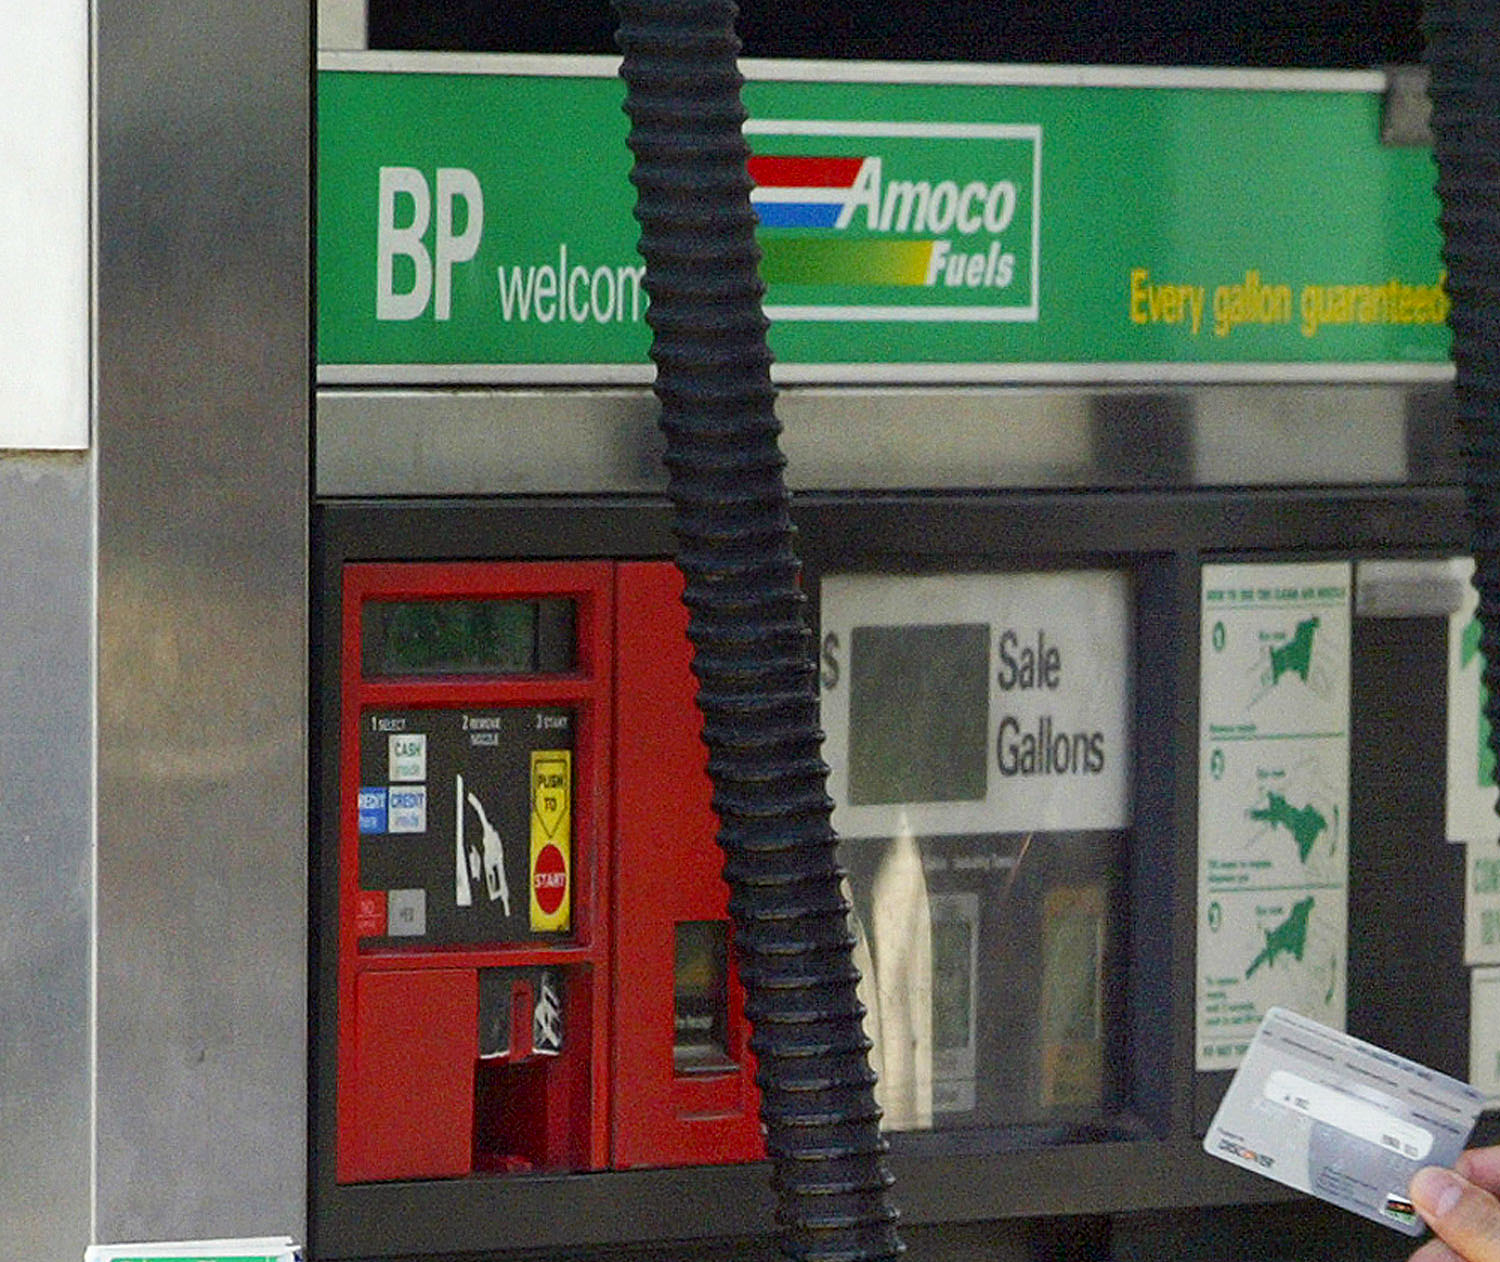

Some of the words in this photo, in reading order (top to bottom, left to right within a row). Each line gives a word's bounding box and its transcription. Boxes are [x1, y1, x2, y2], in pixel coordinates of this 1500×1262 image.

[834, 157, 1016, 234] Amoco
[376, 166, 484, 321] BP
[498, 244, 651, 323] welcom
[924, 240, 1015, 287] Fuels
[1130, 268, 1203, 335] Every
[1212, 268, 1292, 338] gallon
[998, 629, 1061, 691] Sale
[394, 743, 421, 757] CASH
[997, 714, 1105, 776] Gallons
[391, 792, 424, 807] CREDIT
[537, 774, 564, 788] PUSH
[535, 874, 568, 887] START
